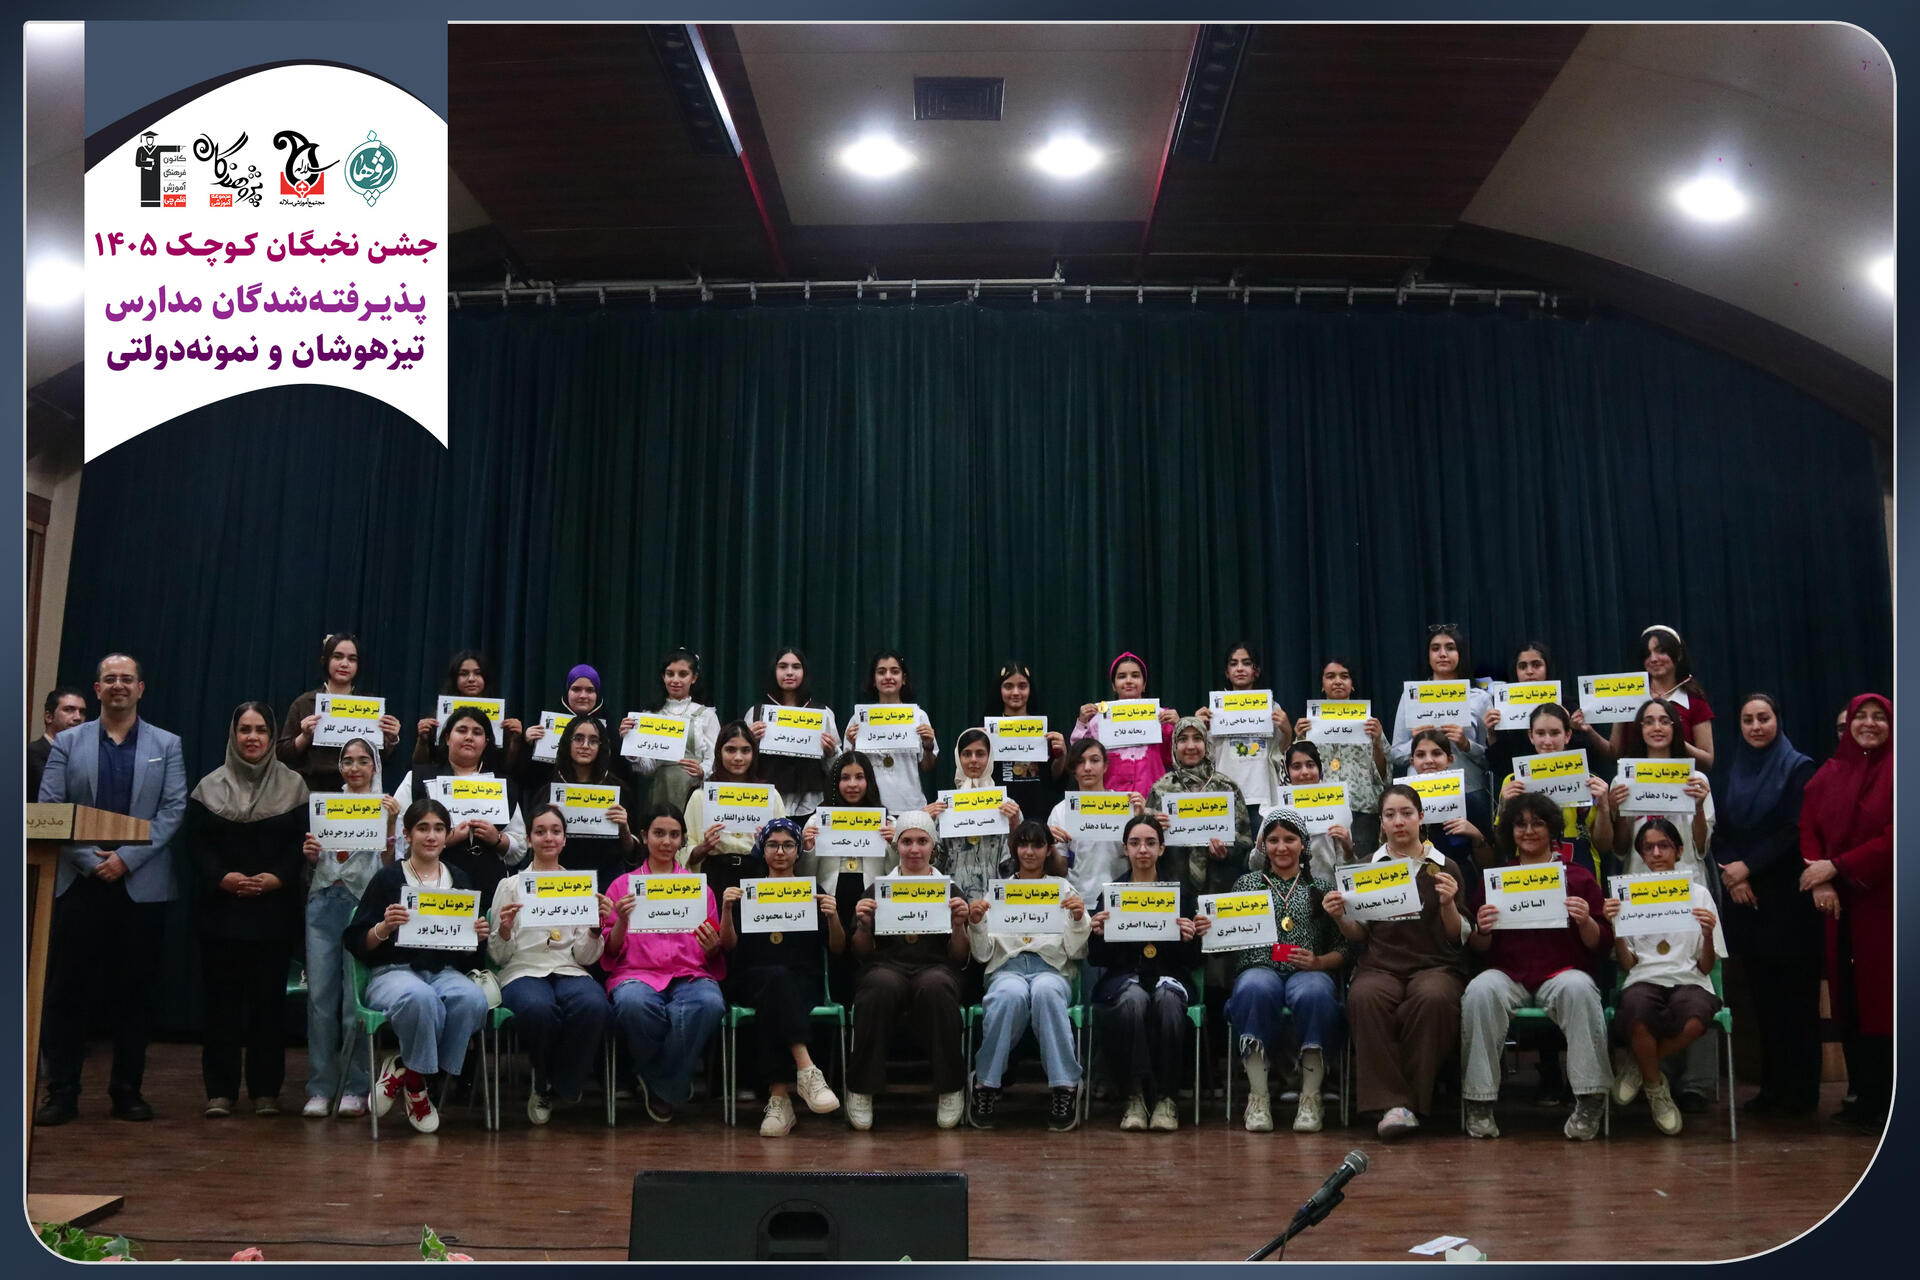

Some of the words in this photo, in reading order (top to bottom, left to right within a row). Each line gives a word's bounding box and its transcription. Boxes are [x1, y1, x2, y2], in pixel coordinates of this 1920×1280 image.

[1595, 684, 1610, 692] ششم
[1613, 681, 1645, 692] تیزهوشان
[1420, 690, 1434, 698] ششم
[1436, 688, 1466, 698] تیزهوشان
[1510, 692, 1524, 700] ششم
[1526, 689, 1557, 699] تیزهوشان
[332, 704, 347, 712] ششم
[1225, 699, 1238, 707] ششم
[349, 705, 380, 715] تیزهوشان
[1128, 709, 1156, 717] تیزهوشان
[1322, 707, 1336, 715] ششم
[1337, 706, 1367, 716] تیزهوشان
[793, 716, 823, 725] تیزهوشان
[870, 713, 883, 721] ششم
[885, 712, 914, 720] تیزهوشان
[358, 727, 374, 735] ستاره
[655, 723, 685, 734] تیزهوشان
[1015, 724, 1043, 733] تیزهوشان
[1532, 764, 1547, 775] ششم
[1549, 759, 1583, 772] تیزهوشان
[1637, 769, 1653, 777] ششم
[1655, 768, 1690, 779] تیزهوشان
[454, 786, 469, 794] ششم
[471, 785, 502, 795] تیزهوشان
[1428, 782, 1460, 792] تیزهوشان
[566, 793, 581, 801] ششم
[584, 794, 615, 804] تیزهوشان
[719, 792, 734, 800] ششم
[736, 793, 768, 802] تیزهوشان
[972, 795, 1003, 806] تیزهوشان
[1295, 794, 1310, 803] ششم
[1312, 791, 1344, 802] تیزهوشان
[1635, 792, 1660, 801] دهقانی
[955, 798, 969, 807] ششم
[1081, 801, 1096, 809] ششم
[1098, 798, 1131, 810] تیزهوشان
[1196, 803, 1228, 812] تیزهوشان
[327, 805, 344, 814] ششم
[346, 804, 381, 814] تیزهوشان
[1179, 804, 1194, 813] ششم
[567, 816, 588, 824] بهادری
[832, 817, 847, 825] ششم
[849, 816, 881, 826] تیزهوشان
[954, 819, 975, 828] هاشمی
[1375, 868, 1409, 884] تیزهوشان
[1523, 872, 1559, 886] تیزهوشان
[557, 881, 592, 892] تیزهوشان
[1356, 876, 1372, 888] ششم
[1503, 877, 1520, 888] ششم
[538, 883, 555, 892] ششم
[648, 885, 664, 895] ششم
[666, 883, 701, 894] تیزهوشان
[777, 887, 812, 897] تیزهوشان
[893, 888, 909, 897] ششم
[911, 887, 945, 897] تیزهوشان
[1652, 884, 1689, 898] تیزهوشان
[758, 888, 775, 898] ششم
[1006, 889, 1023, 899] ششم
[1025, 889, 1059, 899] تیزهوشان
[1631, 888, 1649, 899] ششم
[420, 899, 437, 908] ششم
[439, 899, 475, 911] تیزهوشان
[1141, 897, 1175, 907] تیزهوشان
[1236, 901, 1269, 912] تیزهوشان
[531, 907, 545, 916] نژاد
[1217, 904, 1233, 913] ششم
[1004, 911, 1026, 923] آزمون
